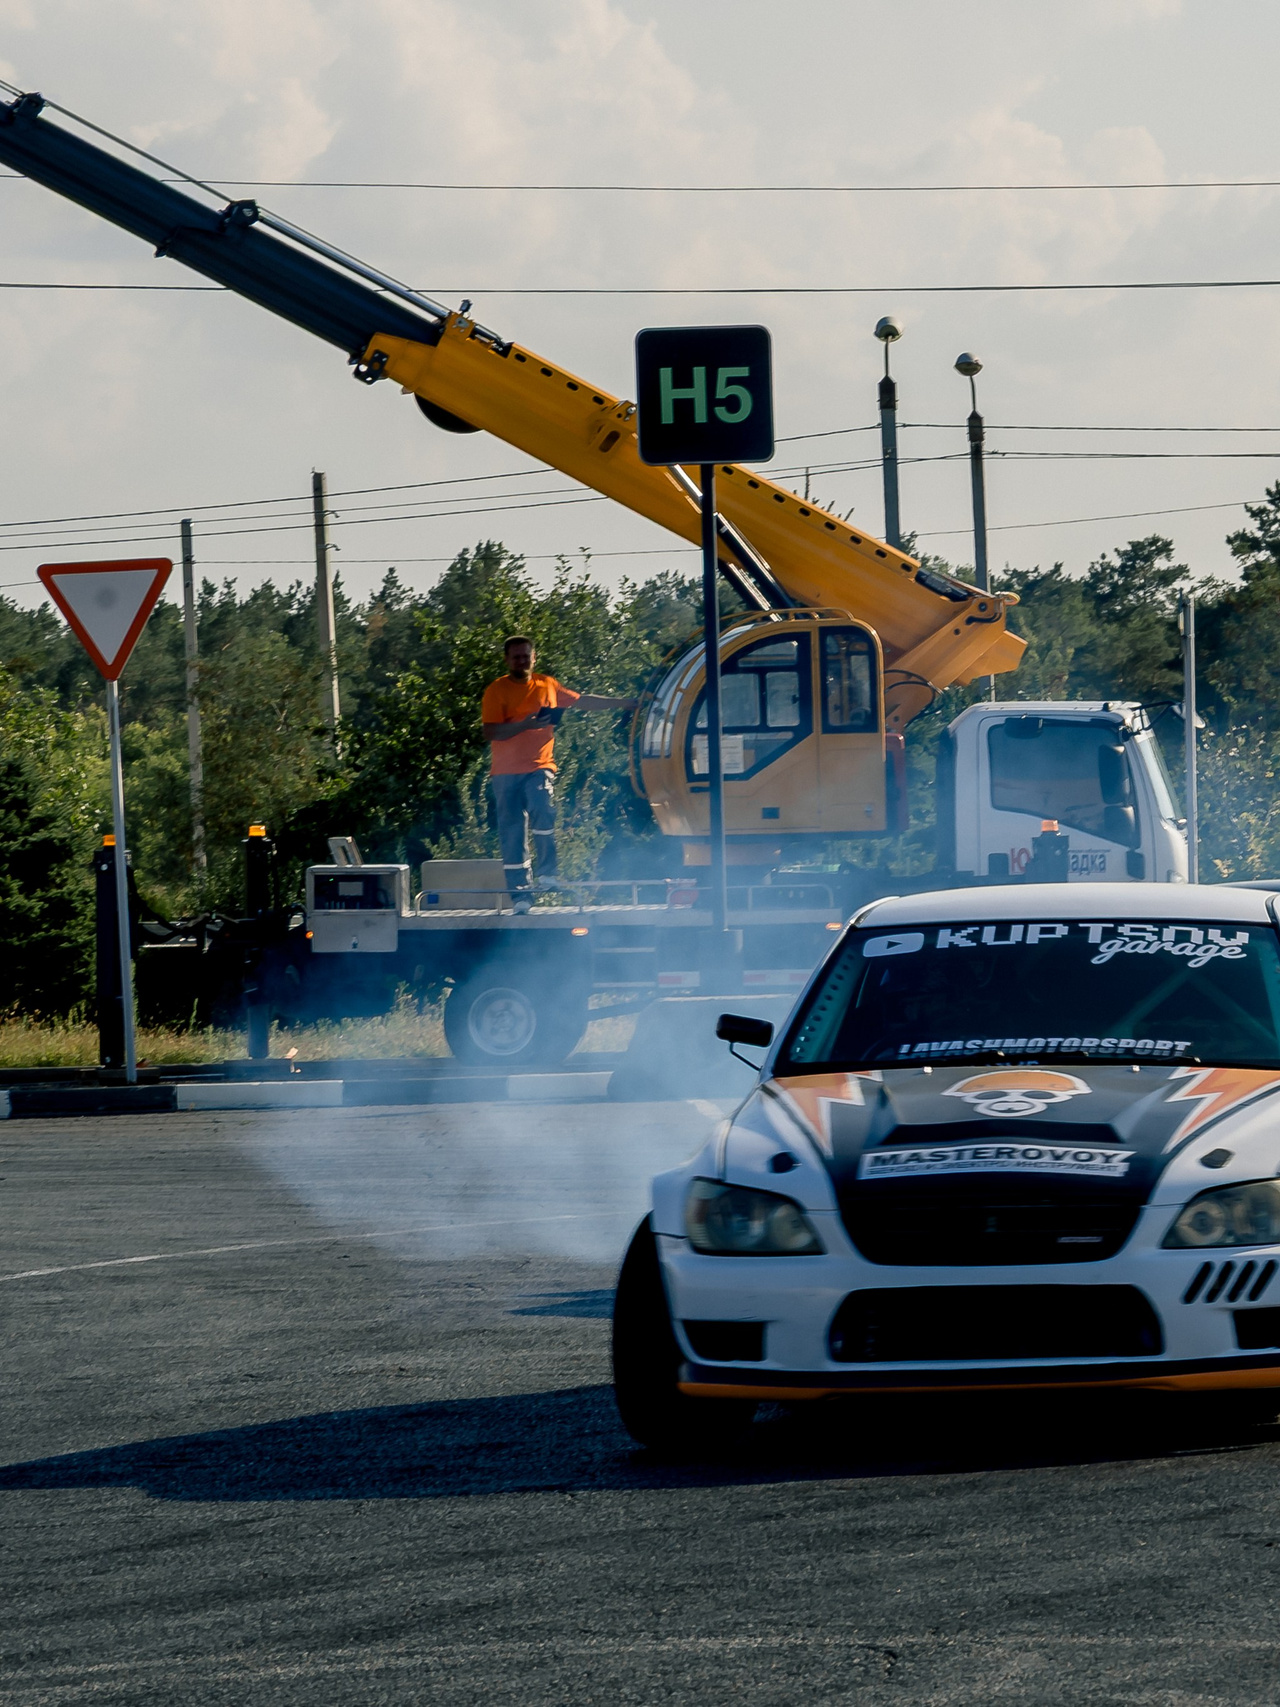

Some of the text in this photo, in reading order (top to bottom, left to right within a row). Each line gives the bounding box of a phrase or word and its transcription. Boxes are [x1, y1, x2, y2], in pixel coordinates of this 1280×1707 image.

[659, 366, 753, 425] H5
[936, 923, 1250, 949] KUPTSOV
[1091, 936, 1248, 968] garage
[897, 1037, 1191, 1059] LAVASHMOTORSPORT
[871, 1146, 1122, 1167] MASTEROVOY
